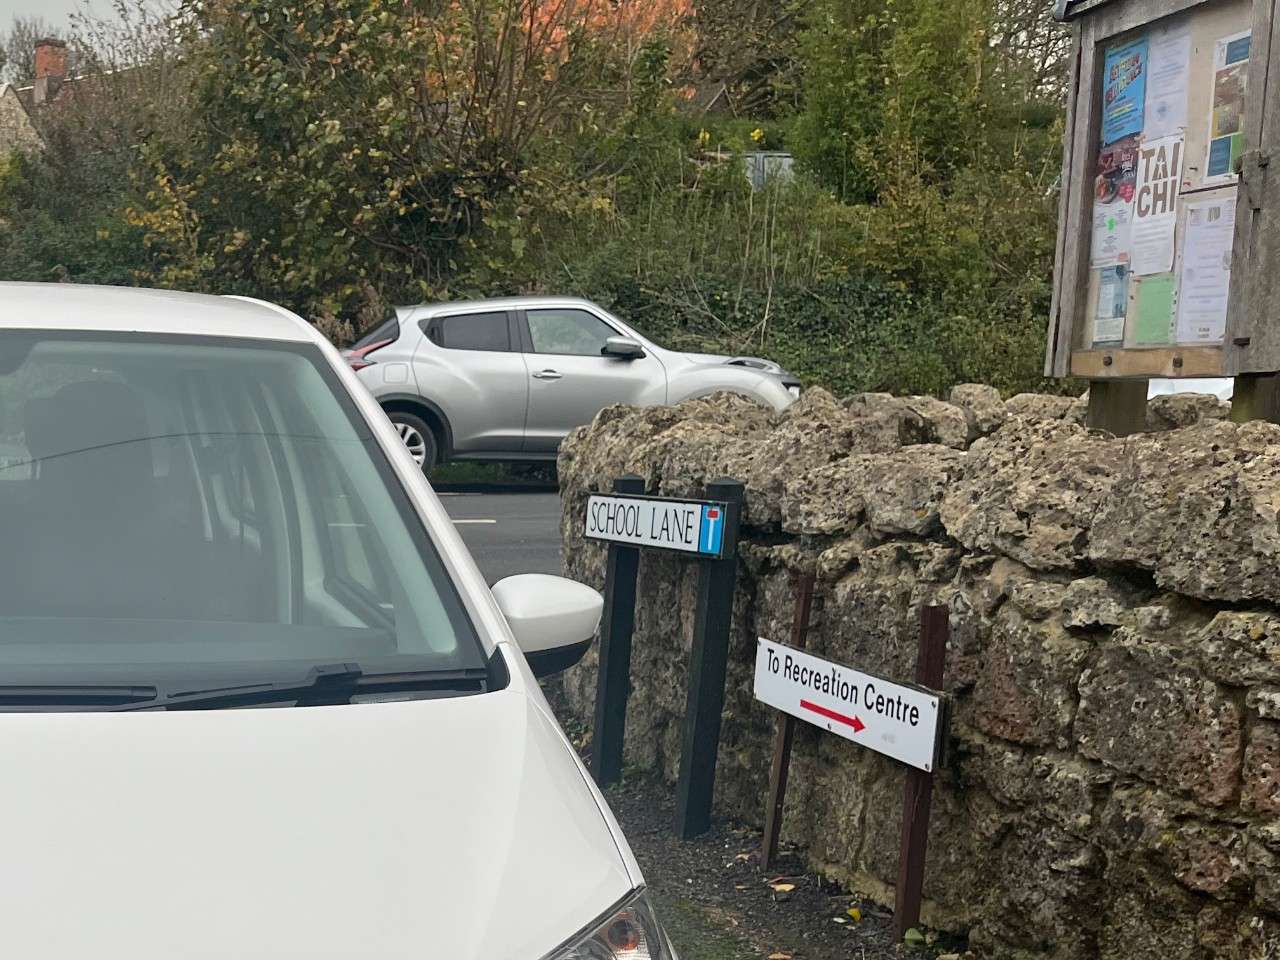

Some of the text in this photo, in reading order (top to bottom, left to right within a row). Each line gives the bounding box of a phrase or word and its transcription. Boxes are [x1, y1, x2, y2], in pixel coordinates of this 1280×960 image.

[1141, 142, 1180, 184] TAI
[1136, 179, 1177, 218] CHI
[590, 501, 695, 544] SCHOOL LANE
[766, 647, 920, 727] To Recreation Centre
